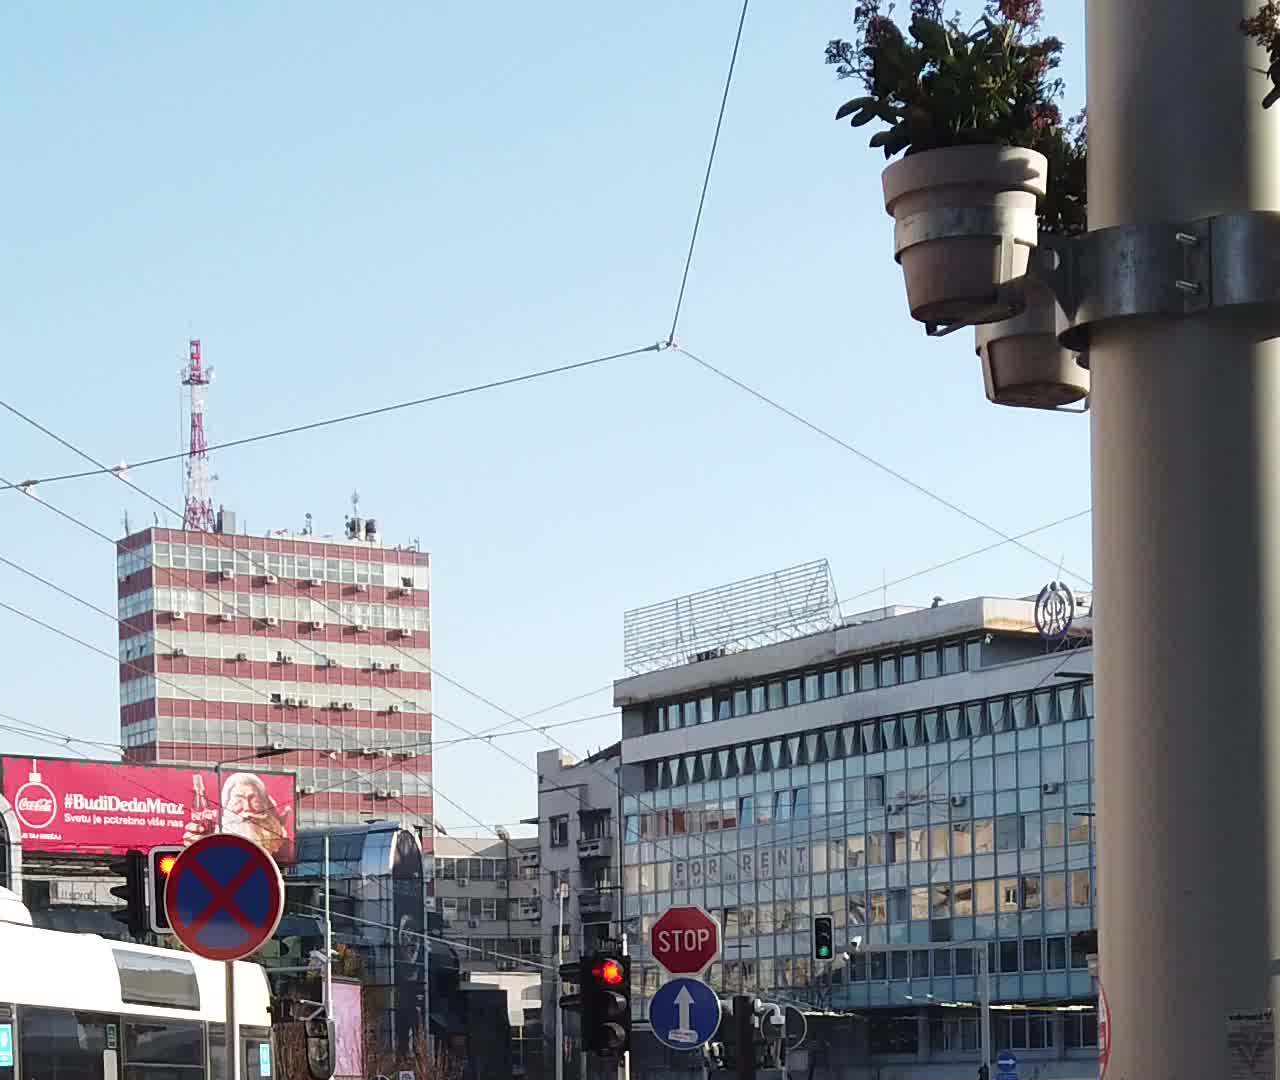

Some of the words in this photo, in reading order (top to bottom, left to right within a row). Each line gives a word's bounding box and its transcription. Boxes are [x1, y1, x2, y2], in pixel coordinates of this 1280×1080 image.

[64, 794, 184, 814] #BudiDedaMraz
[676, 859, 718, 878] FOR
[743, 847, 805, 872] RENT
[658, 928, 710, 953] STOP
